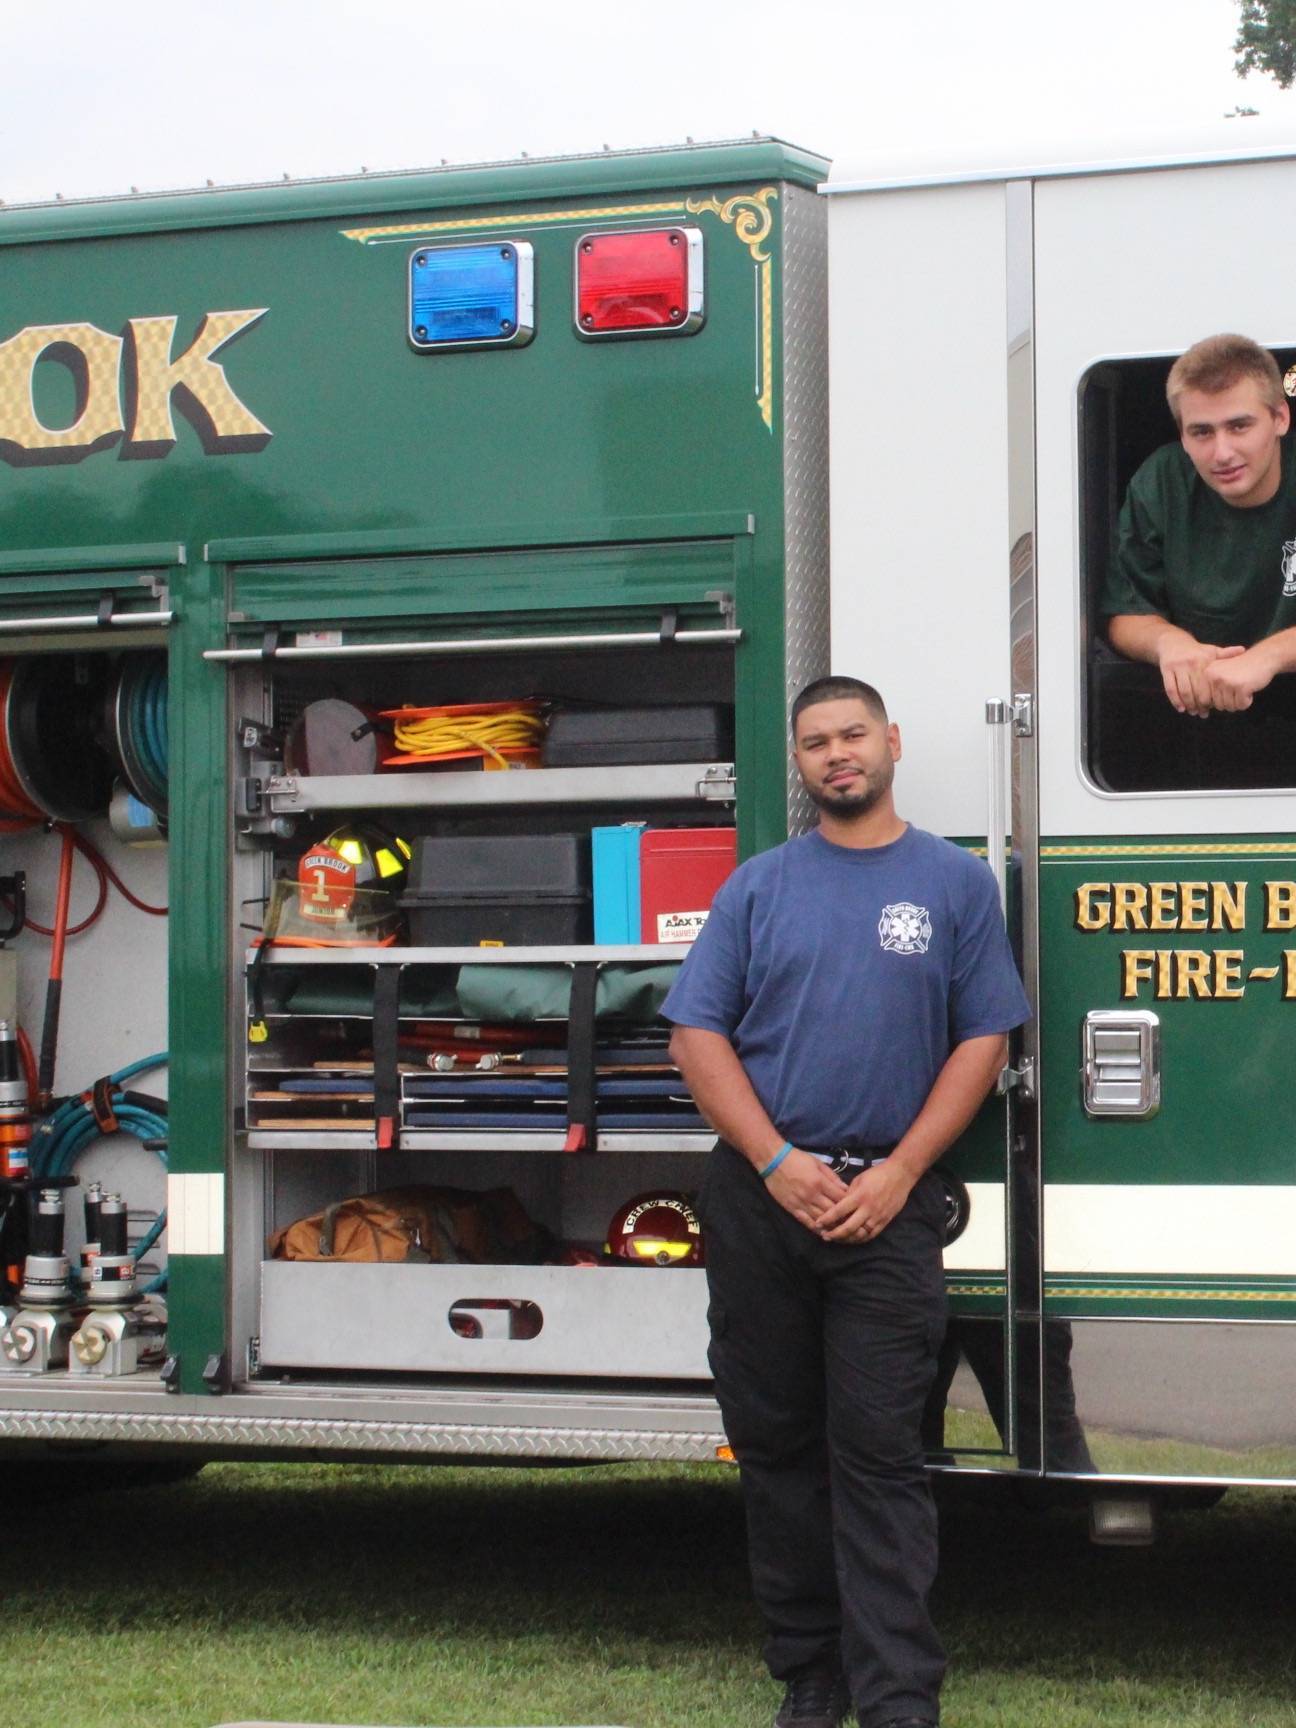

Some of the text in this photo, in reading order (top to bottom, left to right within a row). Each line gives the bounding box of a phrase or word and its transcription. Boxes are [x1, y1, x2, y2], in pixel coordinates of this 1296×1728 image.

[0, 308, 273, 466] OK
[312, 869, 330, 902] 1
[1074, 881, 1247, 931] GREEN
[626, 1200, 659, 1226] CREW
